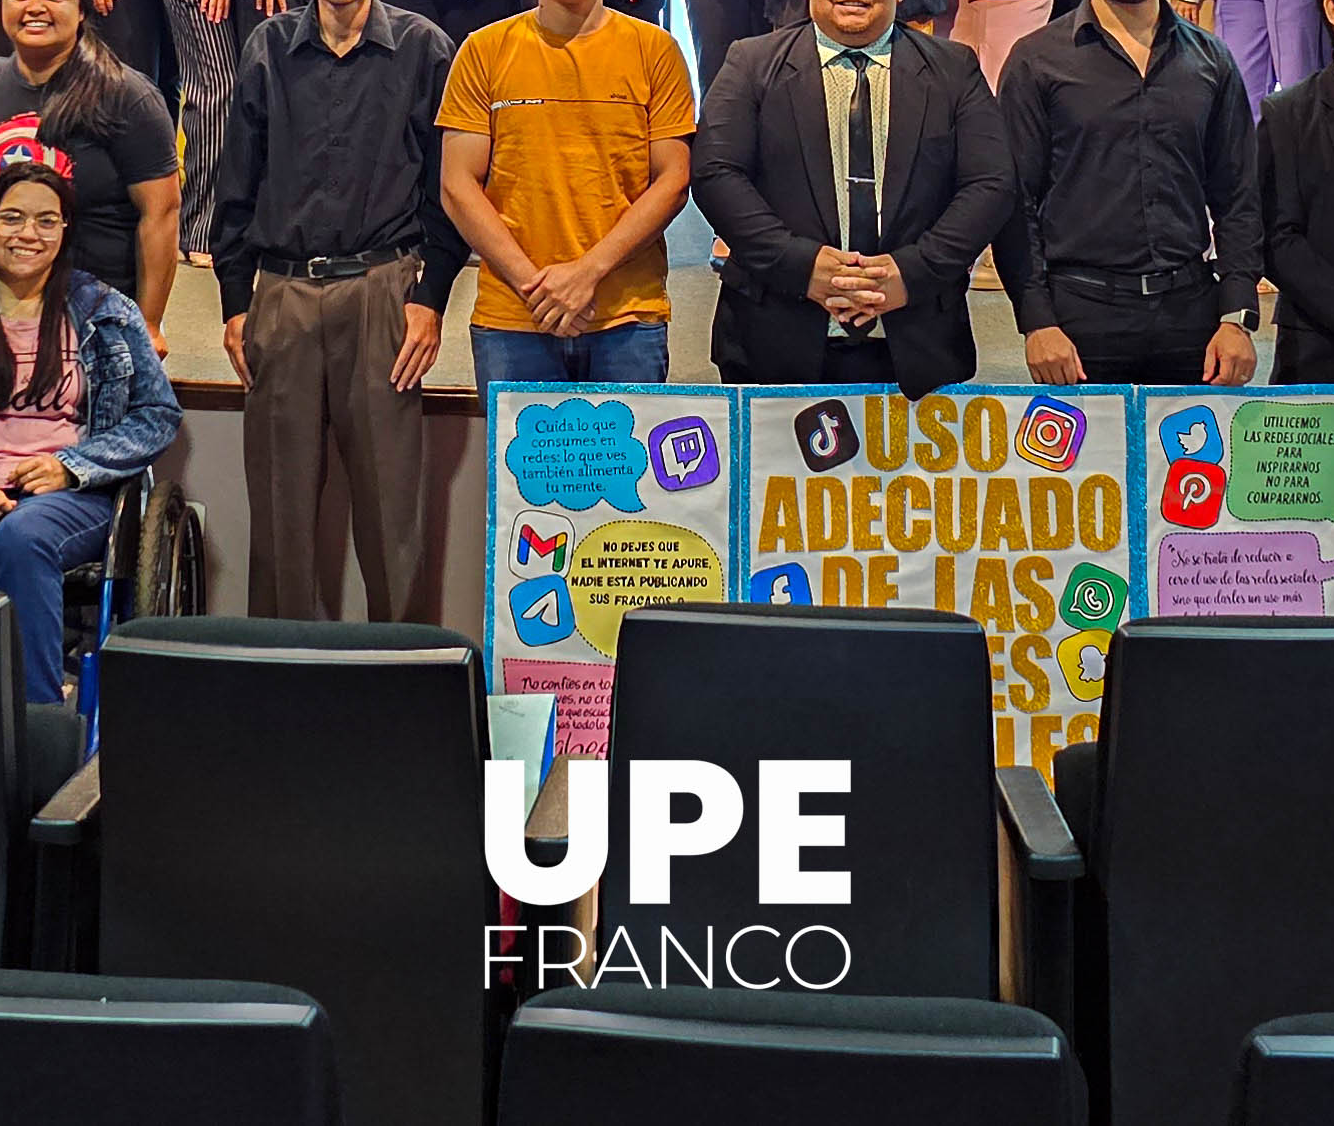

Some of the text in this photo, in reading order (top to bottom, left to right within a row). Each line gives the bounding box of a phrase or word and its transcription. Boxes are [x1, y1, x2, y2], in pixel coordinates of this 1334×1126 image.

[535, 418, 617, 434] Cuida lo que
[1264, 416, 1321, 429] UTILICEMOS
[864, 394, 1008, 473] USO
[1243, 430, 1262, 443] LAS
[1264, 431, 1294, 444] REDES
[531, 436, 616, 448] consumes en
[522, 449, 627, 465] redes: lo que ves
[1276, 447, 1302, 459] PARA
[522, 464, 633, 480] también alimenta
[1256, 461, 1321, 474] INSPIRARNOS
[546, 482, 606, 493] tu mente.
[1266, 476, 1310, 488] NO PARA
[1247, 491, 1323, 505] COMPARARNOS.
[758, 473, 1123, 553] ADECUADO
[603, 541, 679, 552] NO DEJES QUE
[581, 557, 712, 570] EL INTERNET TE APURE,
[1192, 554, 1203, 566] se
[1231, 548, 1242, 564] de
[1245, 548, 1282, 564] reducir
[571, 576, 708, 588] NADIE ESTA PUBLICANDO
[1168, 575, 1189, 586] cero
[1191, 570, 1201, 586] el
[1203, 575, 1218, 585] uso
[1220, 570, 1233, 586] de
[1235, 570, 1250, 586] las
[1251, 570, 1278, 585] redes
[589, 594, 610, 605] SUS
[1172, 589, 1303, 608] sino que darles un uso más
[522, 676, 539, 690] No
[583, 679, 596, 690] en
[579, 695, 592, 704] no
[565, 708, 582, 720] que
